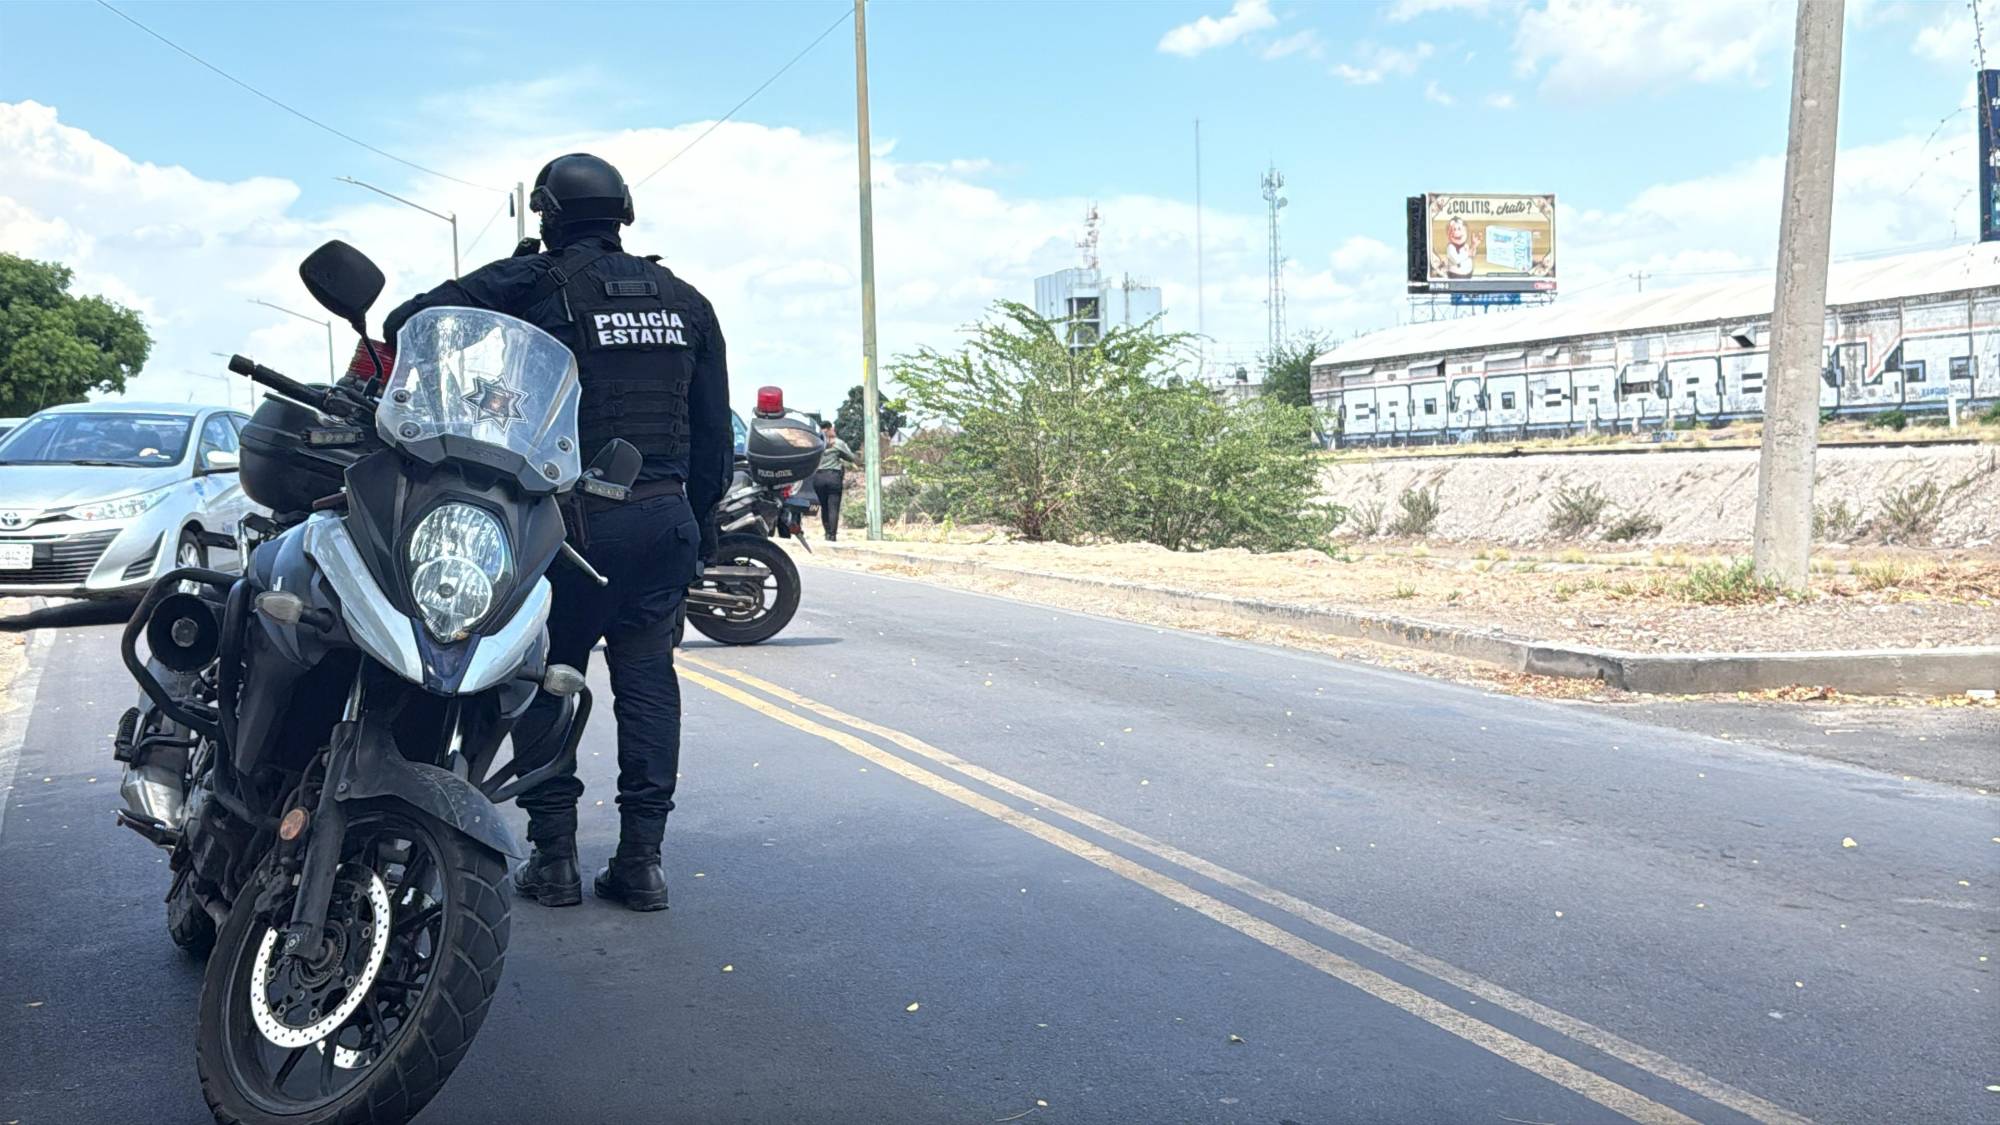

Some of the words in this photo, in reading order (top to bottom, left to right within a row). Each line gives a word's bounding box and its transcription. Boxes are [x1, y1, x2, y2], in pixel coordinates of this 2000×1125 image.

[1446, 200, 1494, 216] ¿COLITIS,
[594, 309, 685, 330] POLICÍA
[597, 328, 688, 346] ESTATAL
